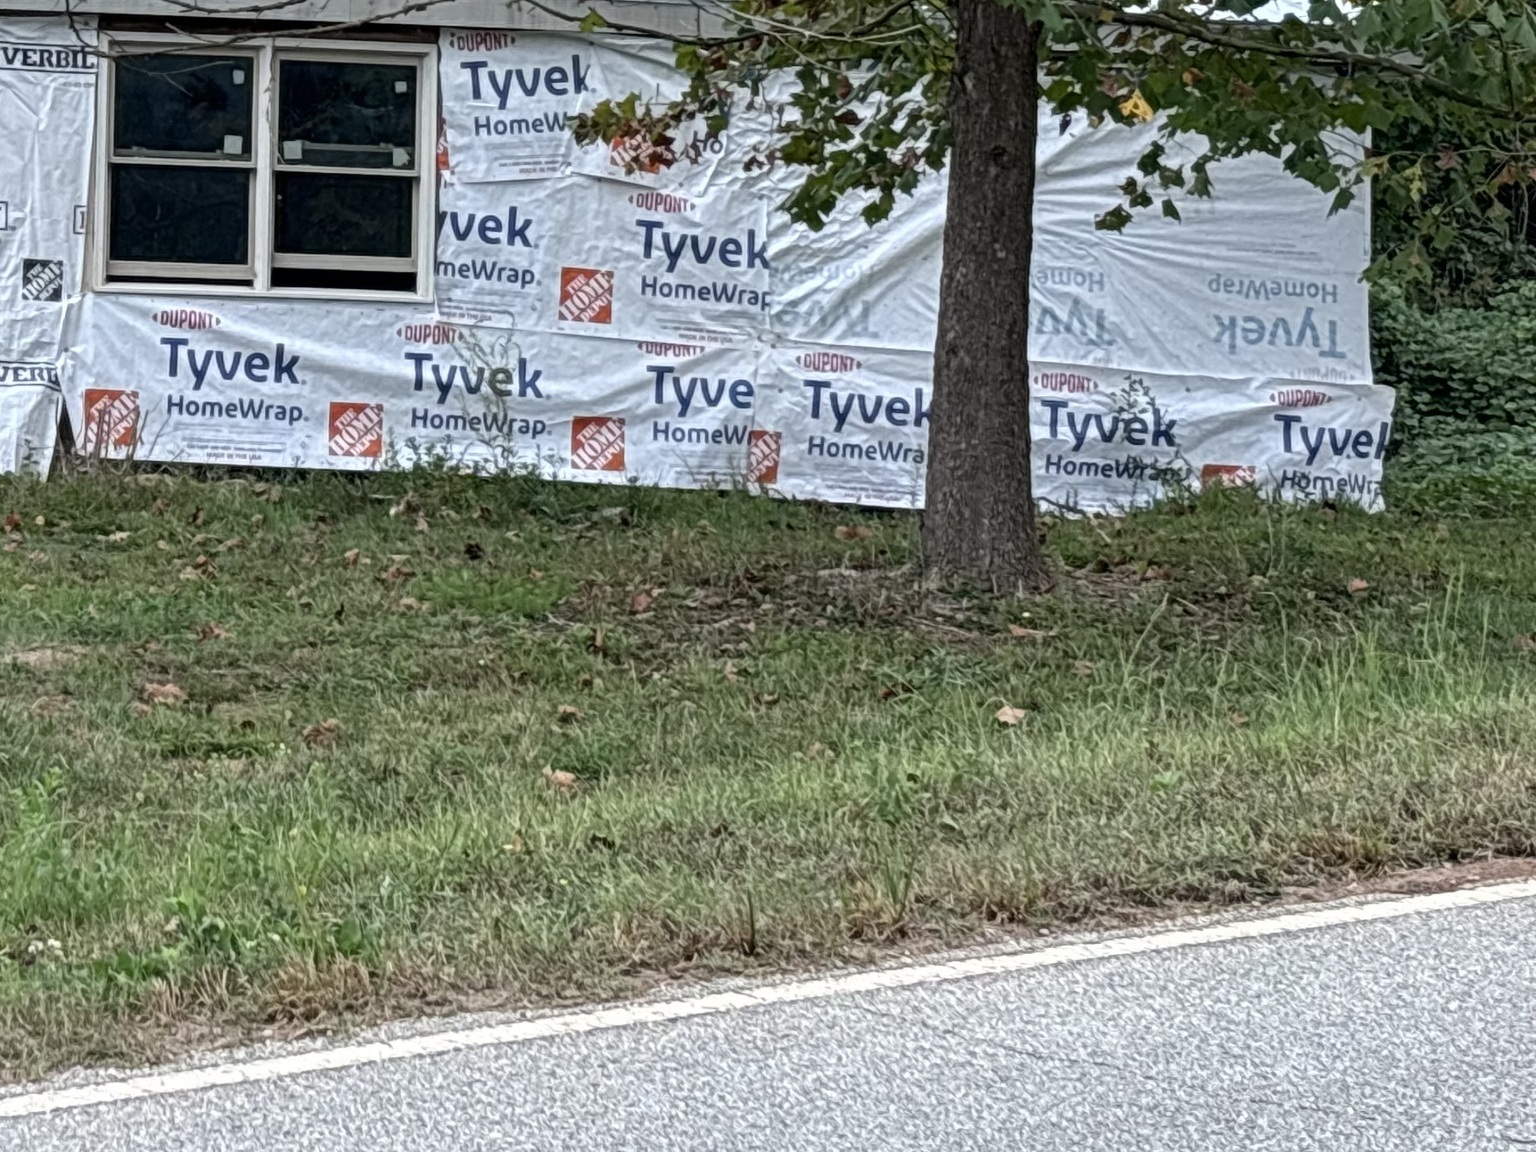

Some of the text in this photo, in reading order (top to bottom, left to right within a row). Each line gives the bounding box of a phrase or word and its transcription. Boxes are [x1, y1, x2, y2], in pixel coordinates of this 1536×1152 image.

[457, 32, 509, 53] DUPONT
[460, 54, 592, 111] Tyvek
[636, 193, 688, 213] DUPONT
[635, 219, 770, 273] Tyvek
[22, 258, 64, 301] HOME
[27, 263, 44, 280] THE
[565, 274, 587, 295] THE
[39, 278, 64, 302] DEPOT
[559, 269, 615, 322] HOME
[160, 309, 214, 330] DUPONT
[580, 294, 613, 325] DEPOT
[404, 324, 457, 345] DUPONT
[1213, 306, 1348, 360] Tyvek
[160, 337, 301, 391] Tyvek
[803, 352, 855, 373] DUPONT
[404, 352, 544, 405] Tyvek
[646, 365, 755, 418] Tyve
[1041, 373, 1093, 393] DUPONT
[166, 394, 305, 426] HomeWrap
[1277, 390, 1328, 408] DUPONT
[328, 403, 384, 457] HOME
[333, 408, 357, 429] THE
[411, 408, 547, 440] HomeWrap
[577, 421, 599, 444] THE
[1041, 400, 1178, 452] Tyvek
[348, 427, 383, 458] DEPOT
[571, 416, 626, 470] HOME
[593, 439, 626, 471] DEPOT
[1045, 454, 1184, 485] HomeWra
